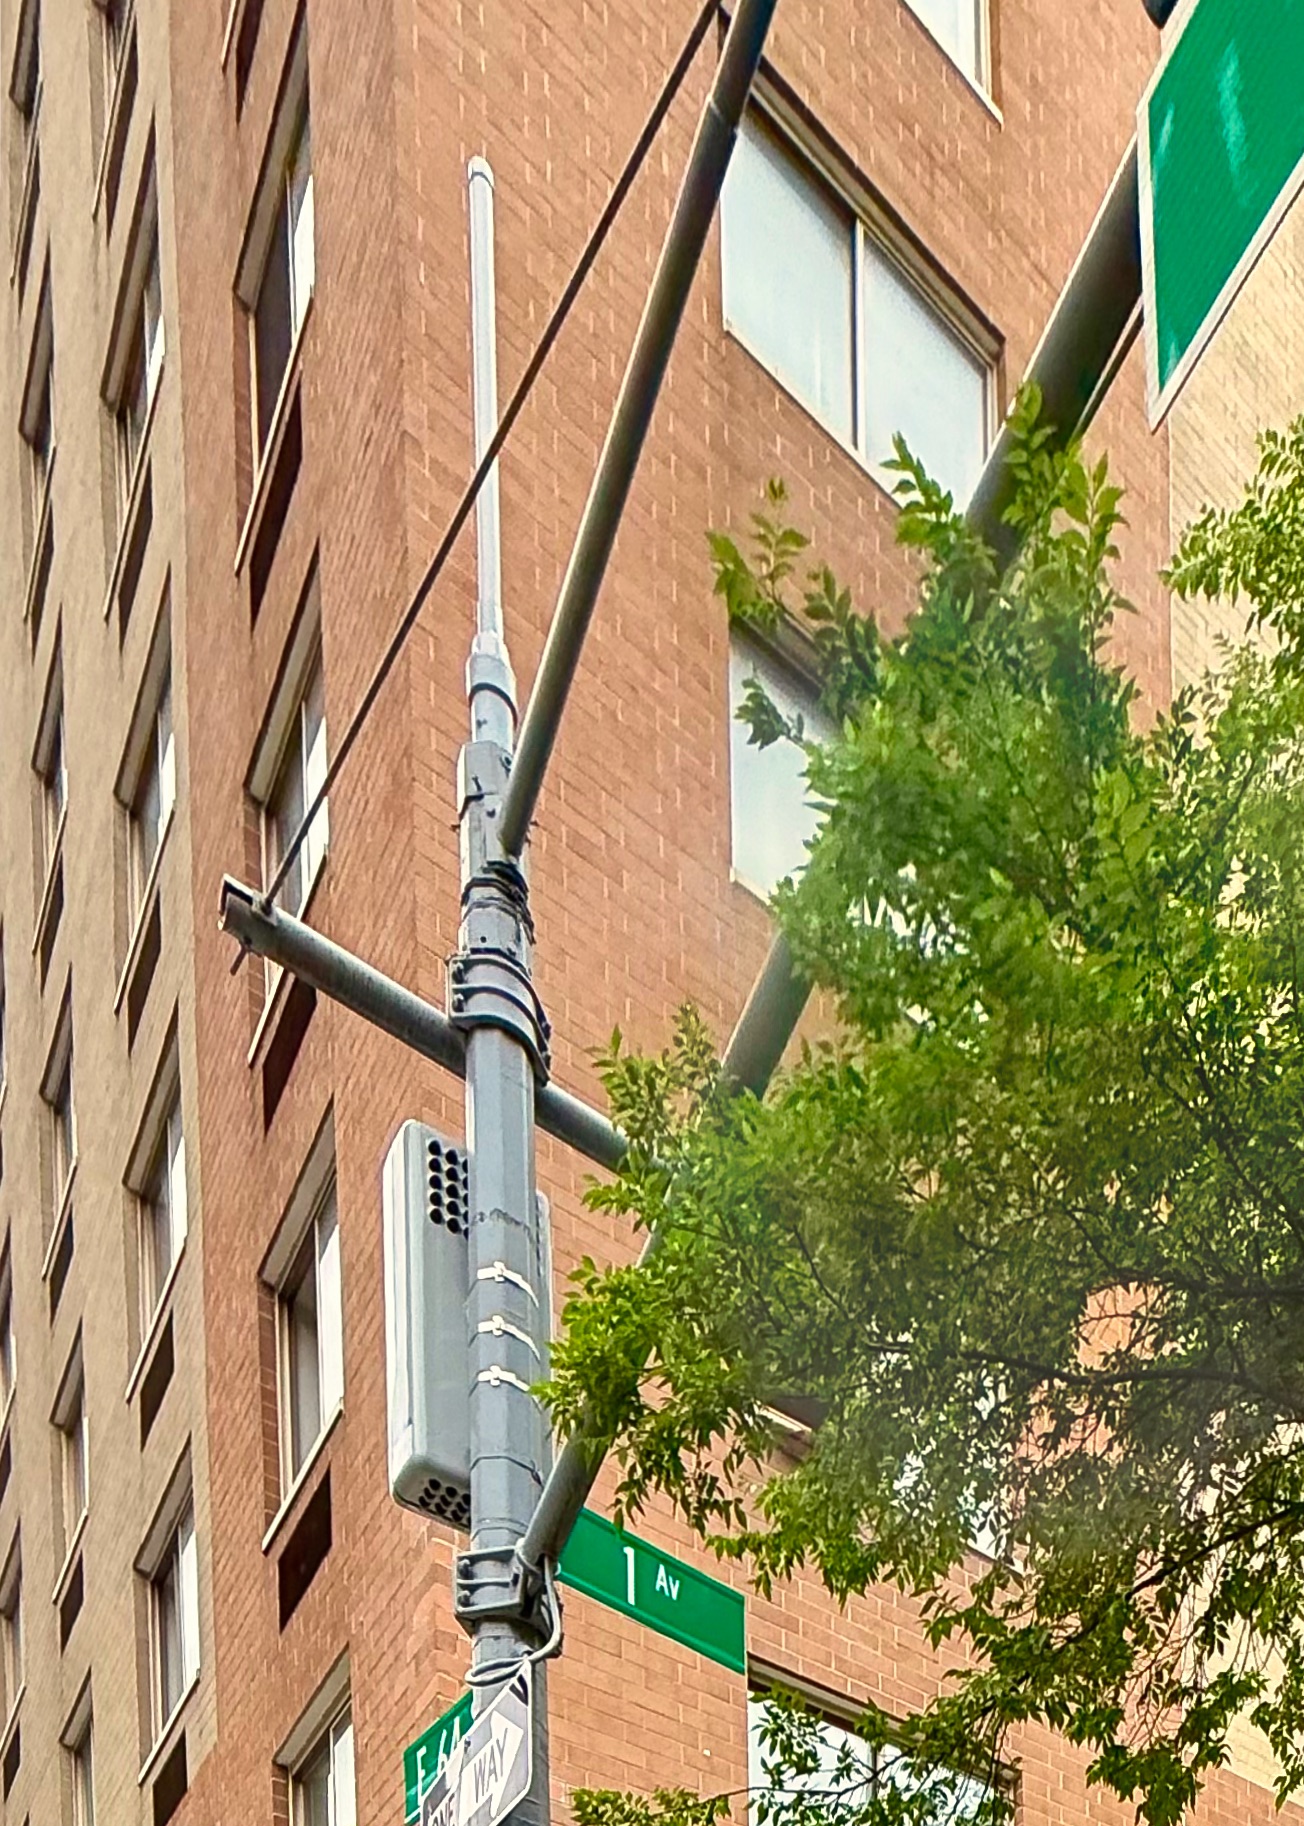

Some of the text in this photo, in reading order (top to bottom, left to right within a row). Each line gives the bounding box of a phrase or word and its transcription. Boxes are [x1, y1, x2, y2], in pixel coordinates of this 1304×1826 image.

[622, 1545, 681, 1606] 1 Av
[473, 1726, 509, 1804] WAY
